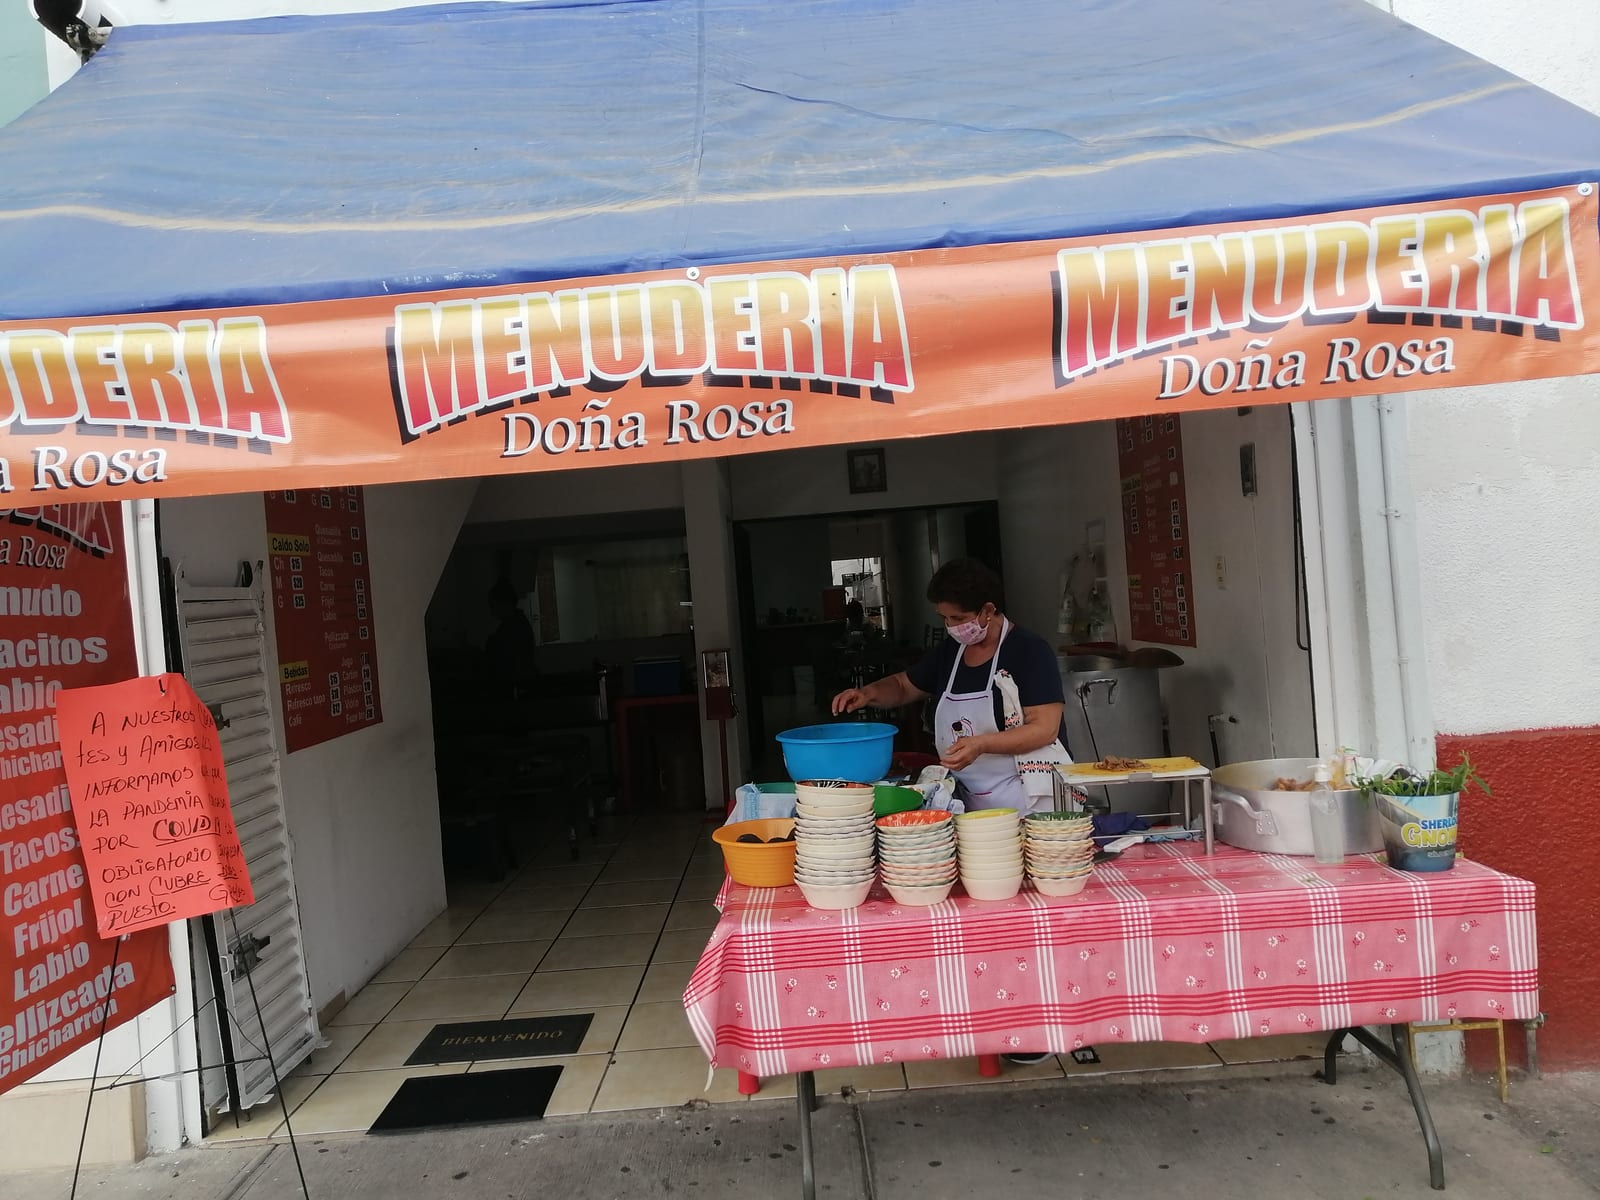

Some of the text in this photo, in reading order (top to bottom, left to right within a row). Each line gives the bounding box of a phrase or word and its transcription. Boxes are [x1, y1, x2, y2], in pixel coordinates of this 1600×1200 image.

[1057, 197, 1584, 378] MENUDERIA
[394, 264, 914, 435] MENUDERIA
[1158, 336, 1456, 399] Doña Rosa
[0, 316, 291, 444] DERIA
[501, 397, 795, 458] Doña Rosa
[34, 446, 168, 491] Rosa
[17, 535, 68, 570] Rosa
[272, 537, 293, 551] Caldo
[294, 539, 310, 553] Solo
[284, 665, 308, 680] Bebidas
[91, 711, 106, 737] A
[0, 783, 71, 832] esadi
[89, 808, 110, 829] LA
[91, 834, 140, 854] POR
[152, 814, 212, 844] COVID
[4, 864, 84, 916] Carne
[104, 885, 141, 909] CON
[148, 870, 212, 897] CUBRE
[14, 898, 84, 959] Frijol
[14, 941, 90, 1002] Labio
[441, 1029, 563, 1047] BIENVENIDO
